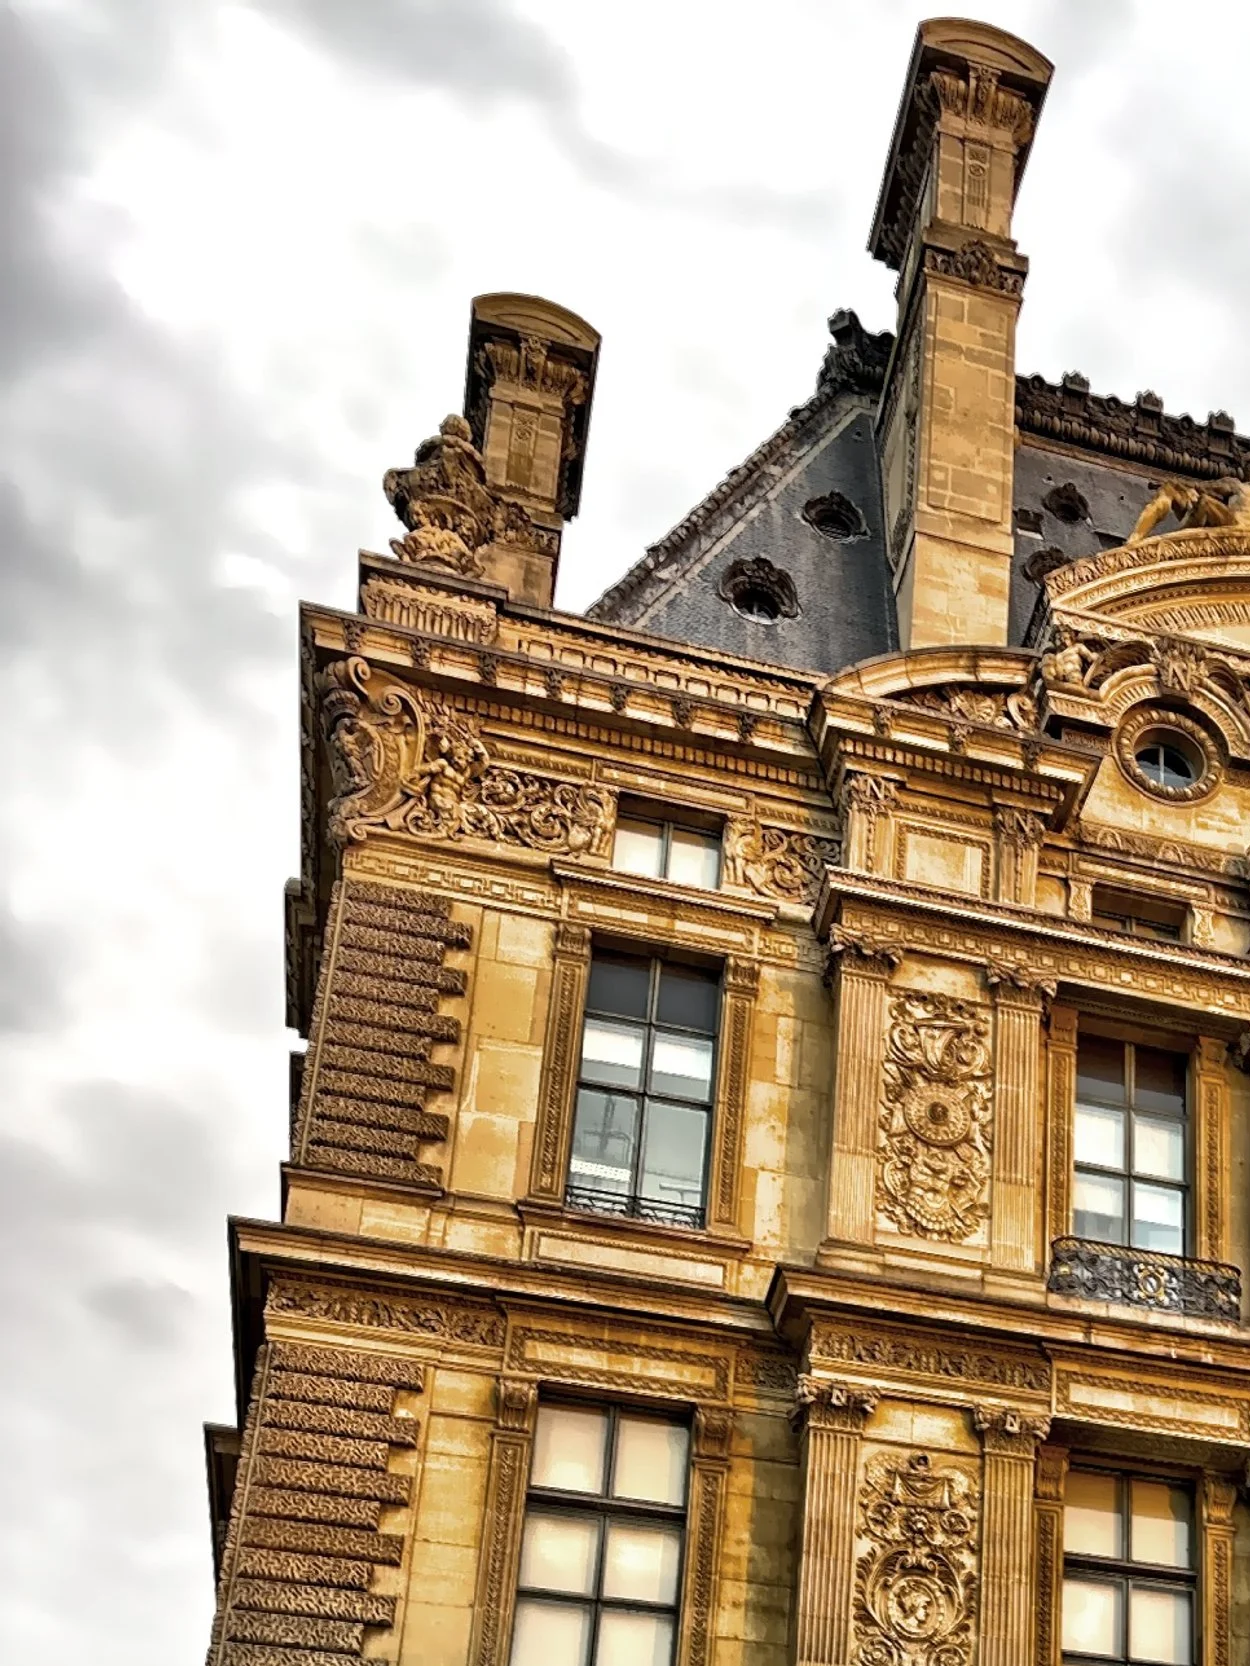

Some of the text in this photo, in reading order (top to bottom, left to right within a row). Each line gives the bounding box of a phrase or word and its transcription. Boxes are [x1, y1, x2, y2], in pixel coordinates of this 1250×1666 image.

[1168, 659, 1192, 690] N
[866, 777, 885, 800] N
[1004, 1414, 1020, 1433] N
